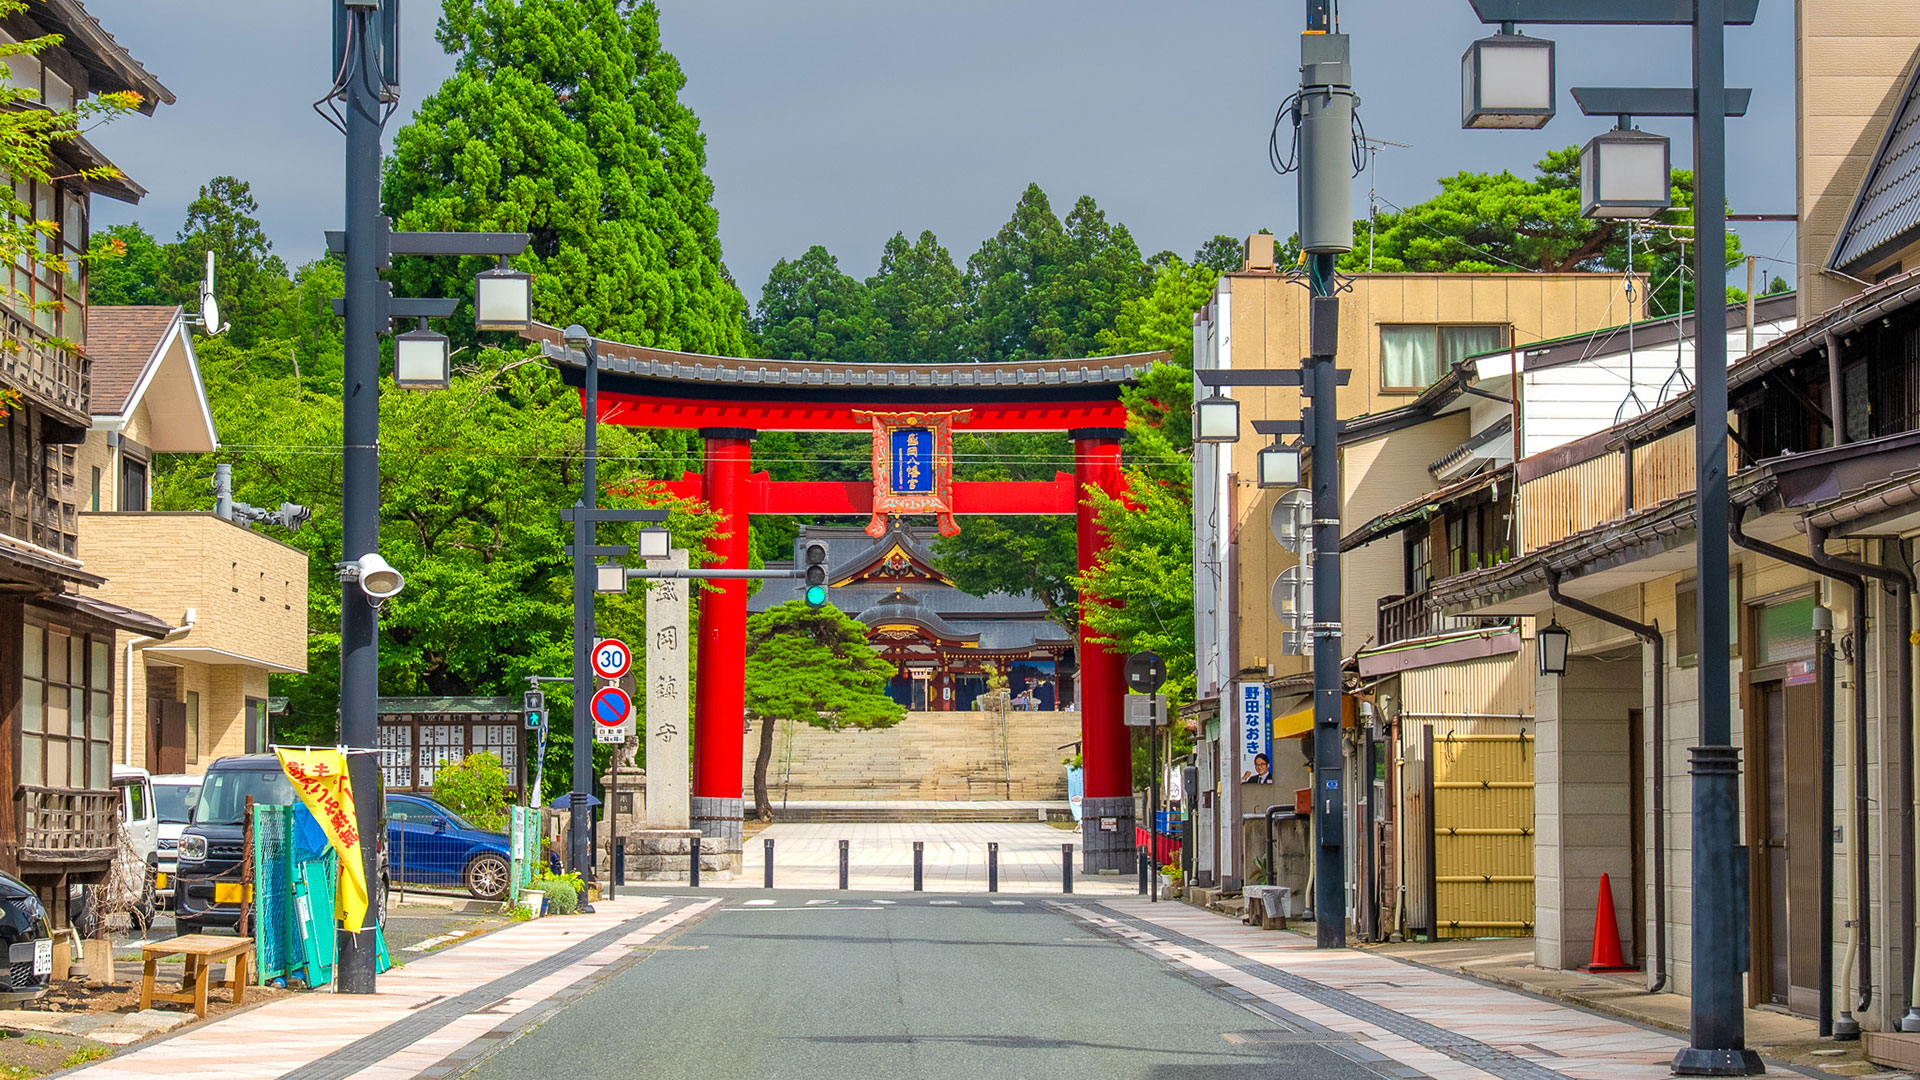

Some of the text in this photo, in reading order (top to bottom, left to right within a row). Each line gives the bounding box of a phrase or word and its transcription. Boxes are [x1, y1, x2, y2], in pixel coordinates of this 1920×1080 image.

[907, 433, 921, 490] 盛岡八幡宮
[600, 650, 623, 668] 30
[1245, 686, 1260, 754] 野田なおき
